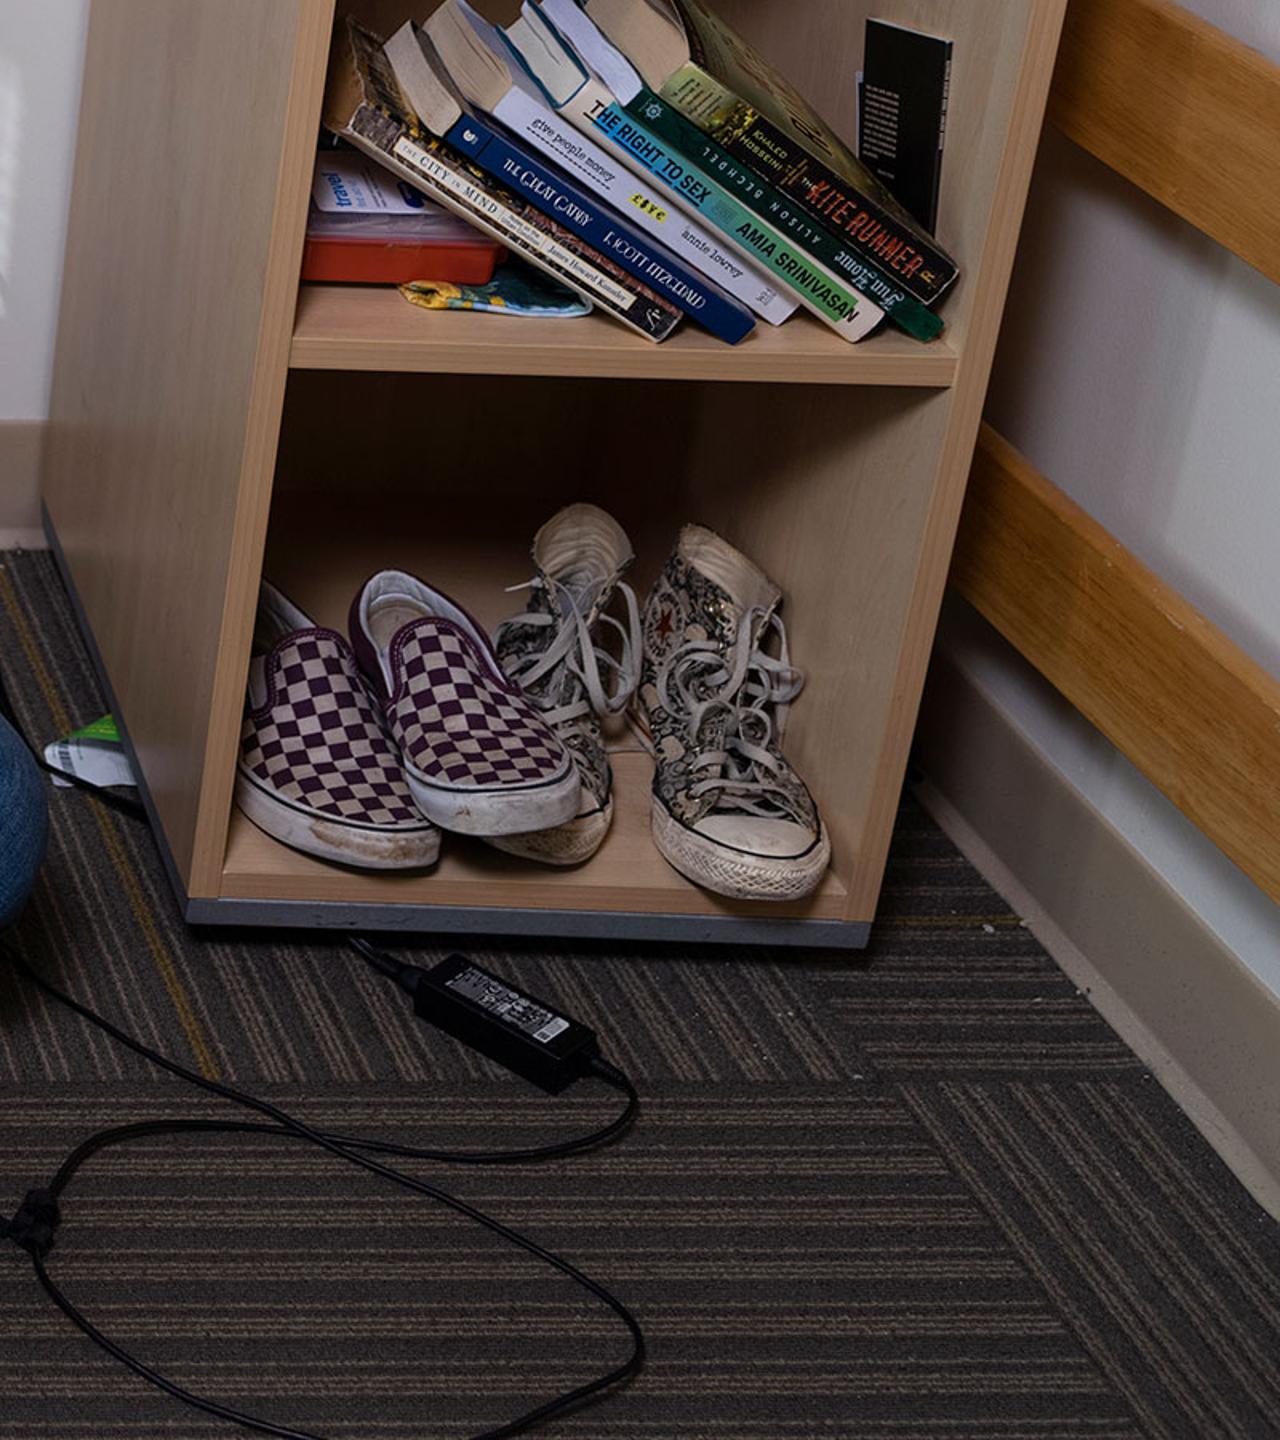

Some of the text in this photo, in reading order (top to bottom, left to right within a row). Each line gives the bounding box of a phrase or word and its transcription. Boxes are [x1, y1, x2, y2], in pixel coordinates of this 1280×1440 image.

[531, 117, 616, 183] give people money
[590, 100, 713, 204] THE RIGHT TO SEX
[740, 135, 785, 170] HOSSEINI
[752, 128, 789, 159] KHALED
[321, 171, 353, 207] travel
[419, 155, 450, 182] CITY
[463, 186, 499, 215] MIND
[702, 147, 822, 245] ALISON BECHDEL
[610, 237, 650, 268] SCOTT
[681, 228, 744, 279] annie lowrey
[804, 180, 858, 223] KITE
[850, 207, 925, 280] RUNNER
[735, 222, 860, 324] AMIA SRINIVASAN
[833, 250, 874, 290] Home
